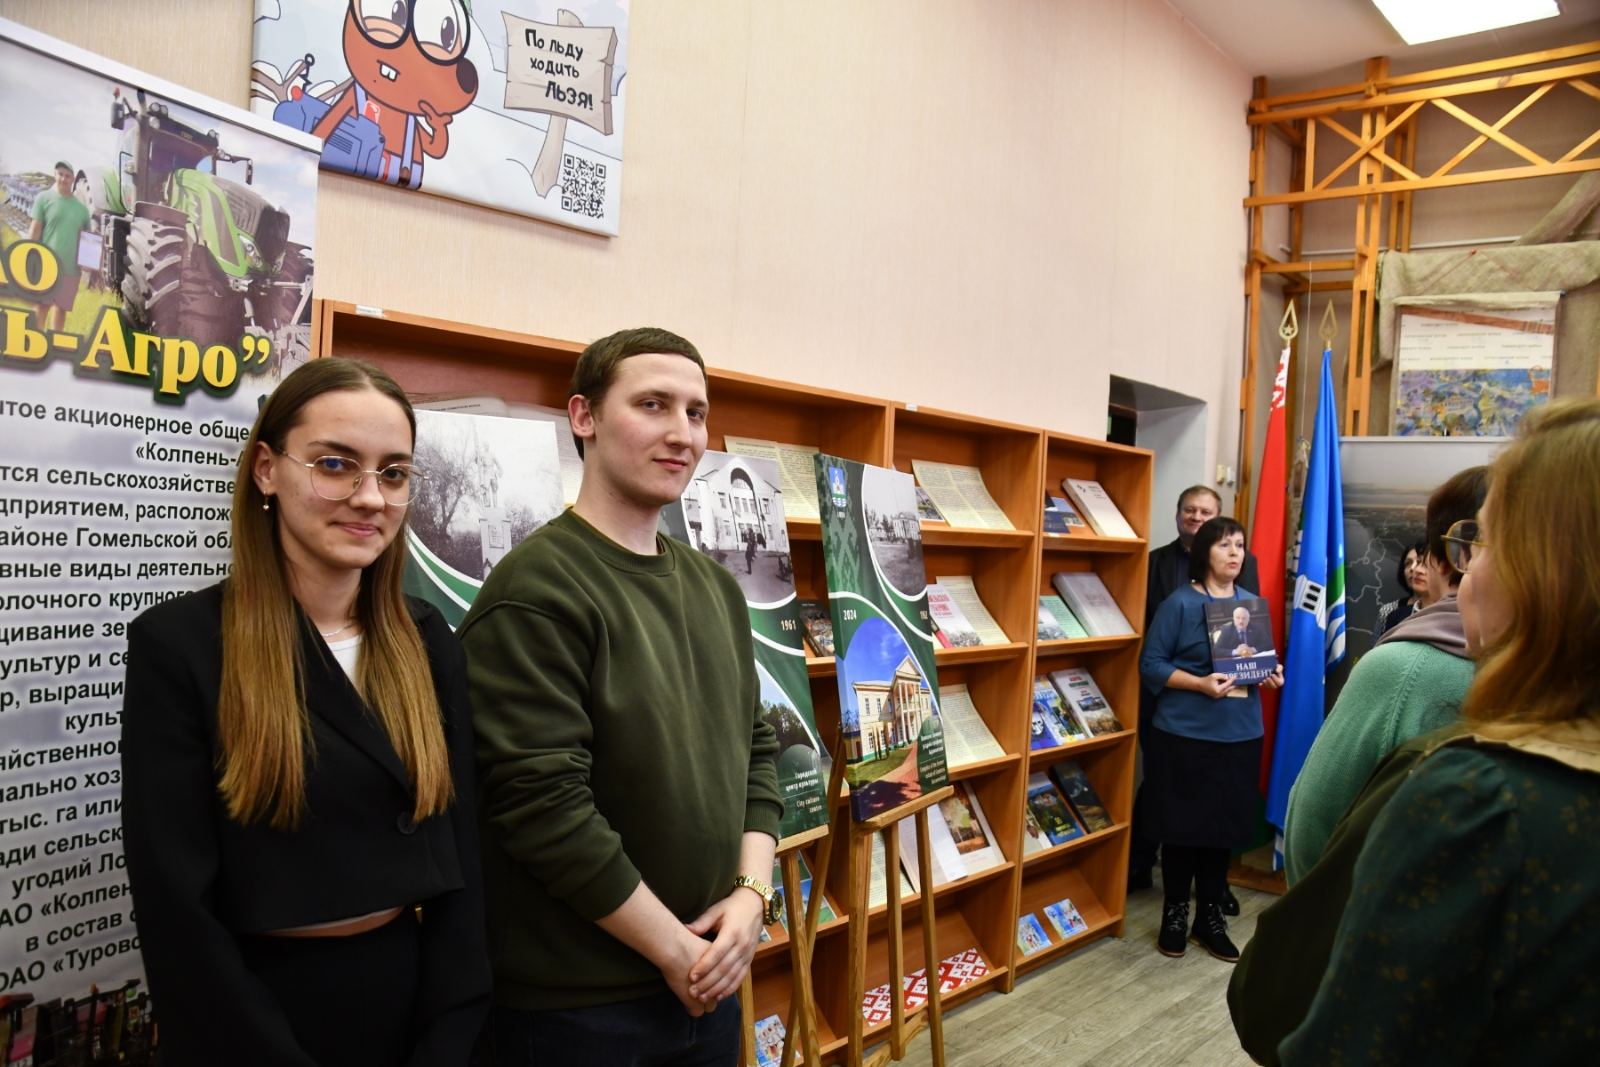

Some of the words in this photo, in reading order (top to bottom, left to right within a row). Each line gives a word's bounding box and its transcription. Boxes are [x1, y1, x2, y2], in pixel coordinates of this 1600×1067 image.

[525, 28, 545, 50] По
[549, 39, 583, 61] льду
[530, 57, 580, 78] ходить
[0, 241, 58, 291] О
[0, 307, 270, 395] ь-Агро”
[54, 406, 192, 436] акционерное
[199, 420, 249, 442] обще
[136, 442, 244, 467] «Колпень-
[0, 466, 39, 483] тся
[136, 504, 233, 523] располож
[76, 527, 197, 548] Гомельской
[0, 563, 62, 578] вные
[70, 563, 131, 580] виды
[781, 619, 796, 631] 1961
[843, 609, 857, 621] 2024
[102, 622, 130, 640] зе
[88, 653, 101, 668] и
[1236, 662, 1257, 671] НАШ
[0, 691, 20, 712] р,
[29, 681, 123, 705] выращи
[0, 740, 122, 771] йственно
[0, 776, 77, 804] ально
[84, 770, 121, 788] хоз
[56, 805, 78, 823] га
[44, 826, 123, 856] сельск
[12, 857, 91, 900] угодий
[26, 936, 39, 953] в
[47, 912, 122, 946] состав
